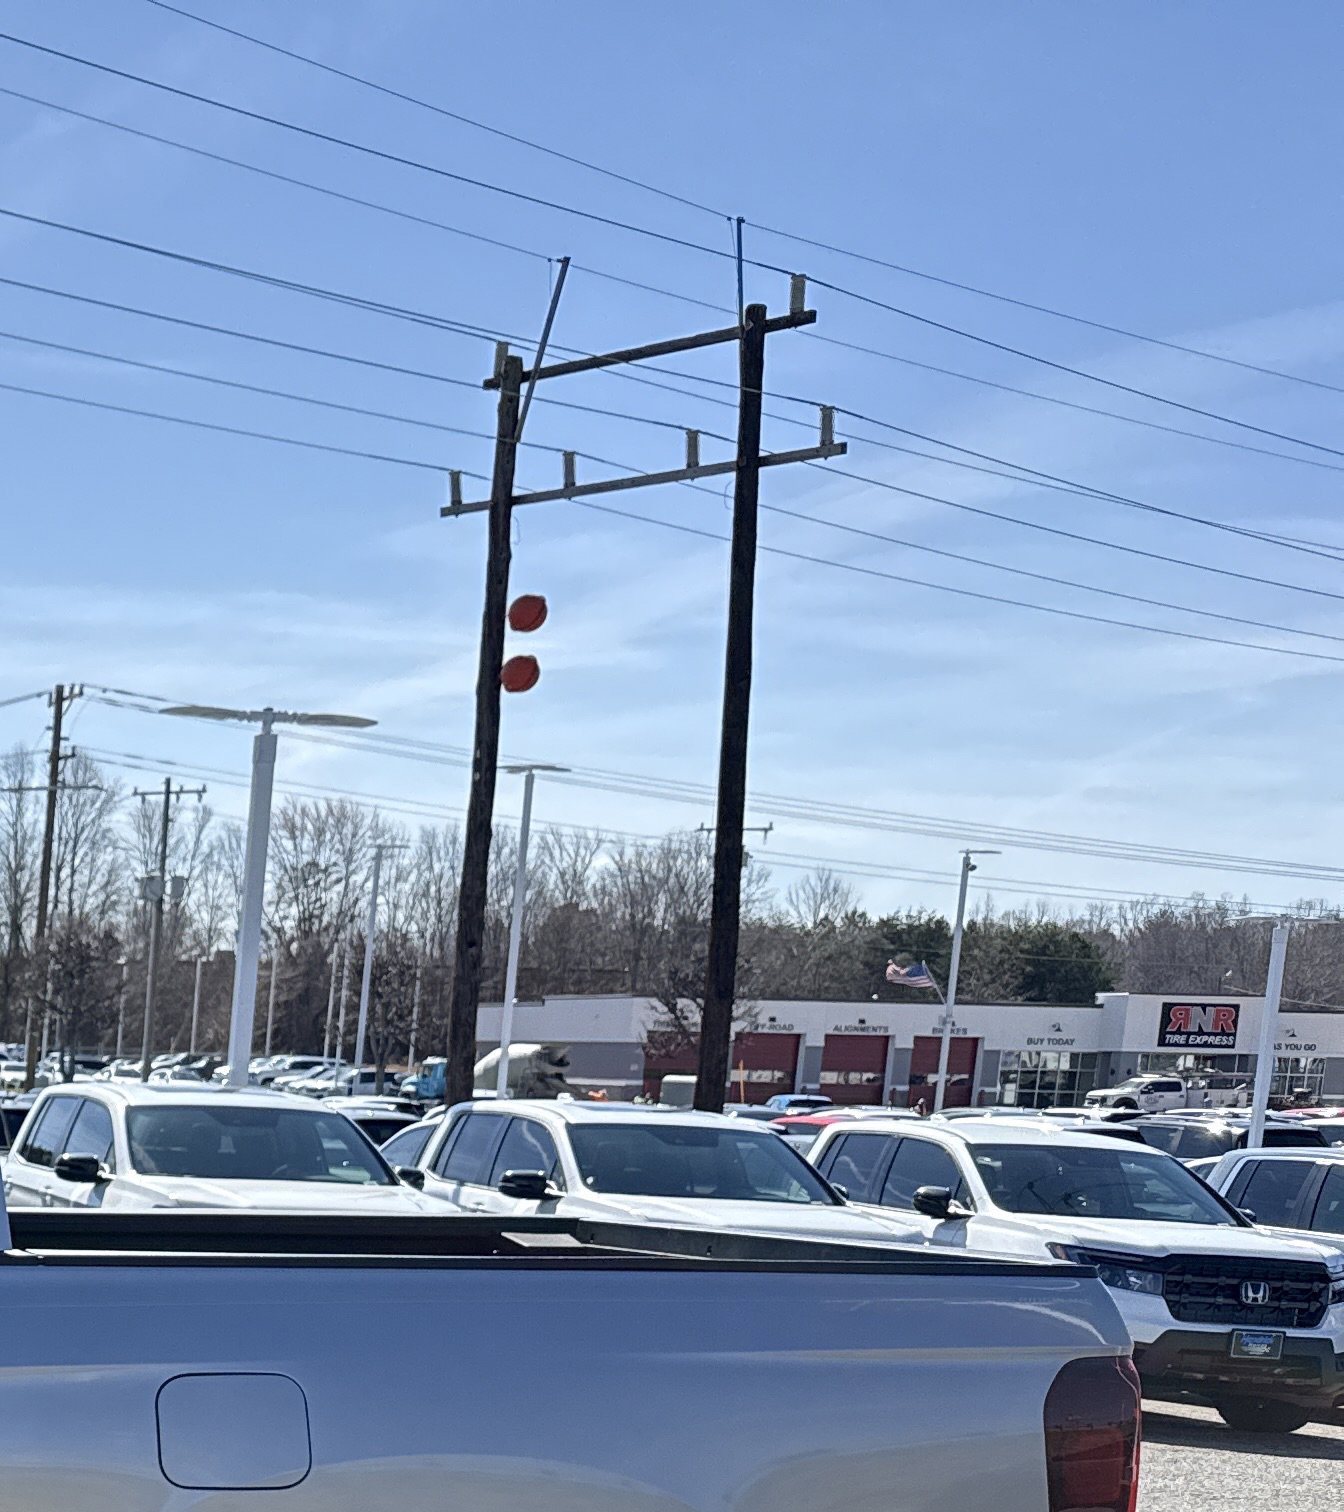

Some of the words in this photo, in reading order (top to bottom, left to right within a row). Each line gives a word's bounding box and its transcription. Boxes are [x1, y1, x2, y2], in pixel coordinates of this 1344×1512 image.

[1166, 1006, 1235, 1033] RNR
[832, 1025, 889, 1033] ALIGNMENTS
[932, 1027, 968, 1035] BRKES
[1164, 1035, 1186, 1044] TIRE
[1188, 1035, 1235, 1046] EXPRESS
[1285, 1043, 1301, 1051] YOU
